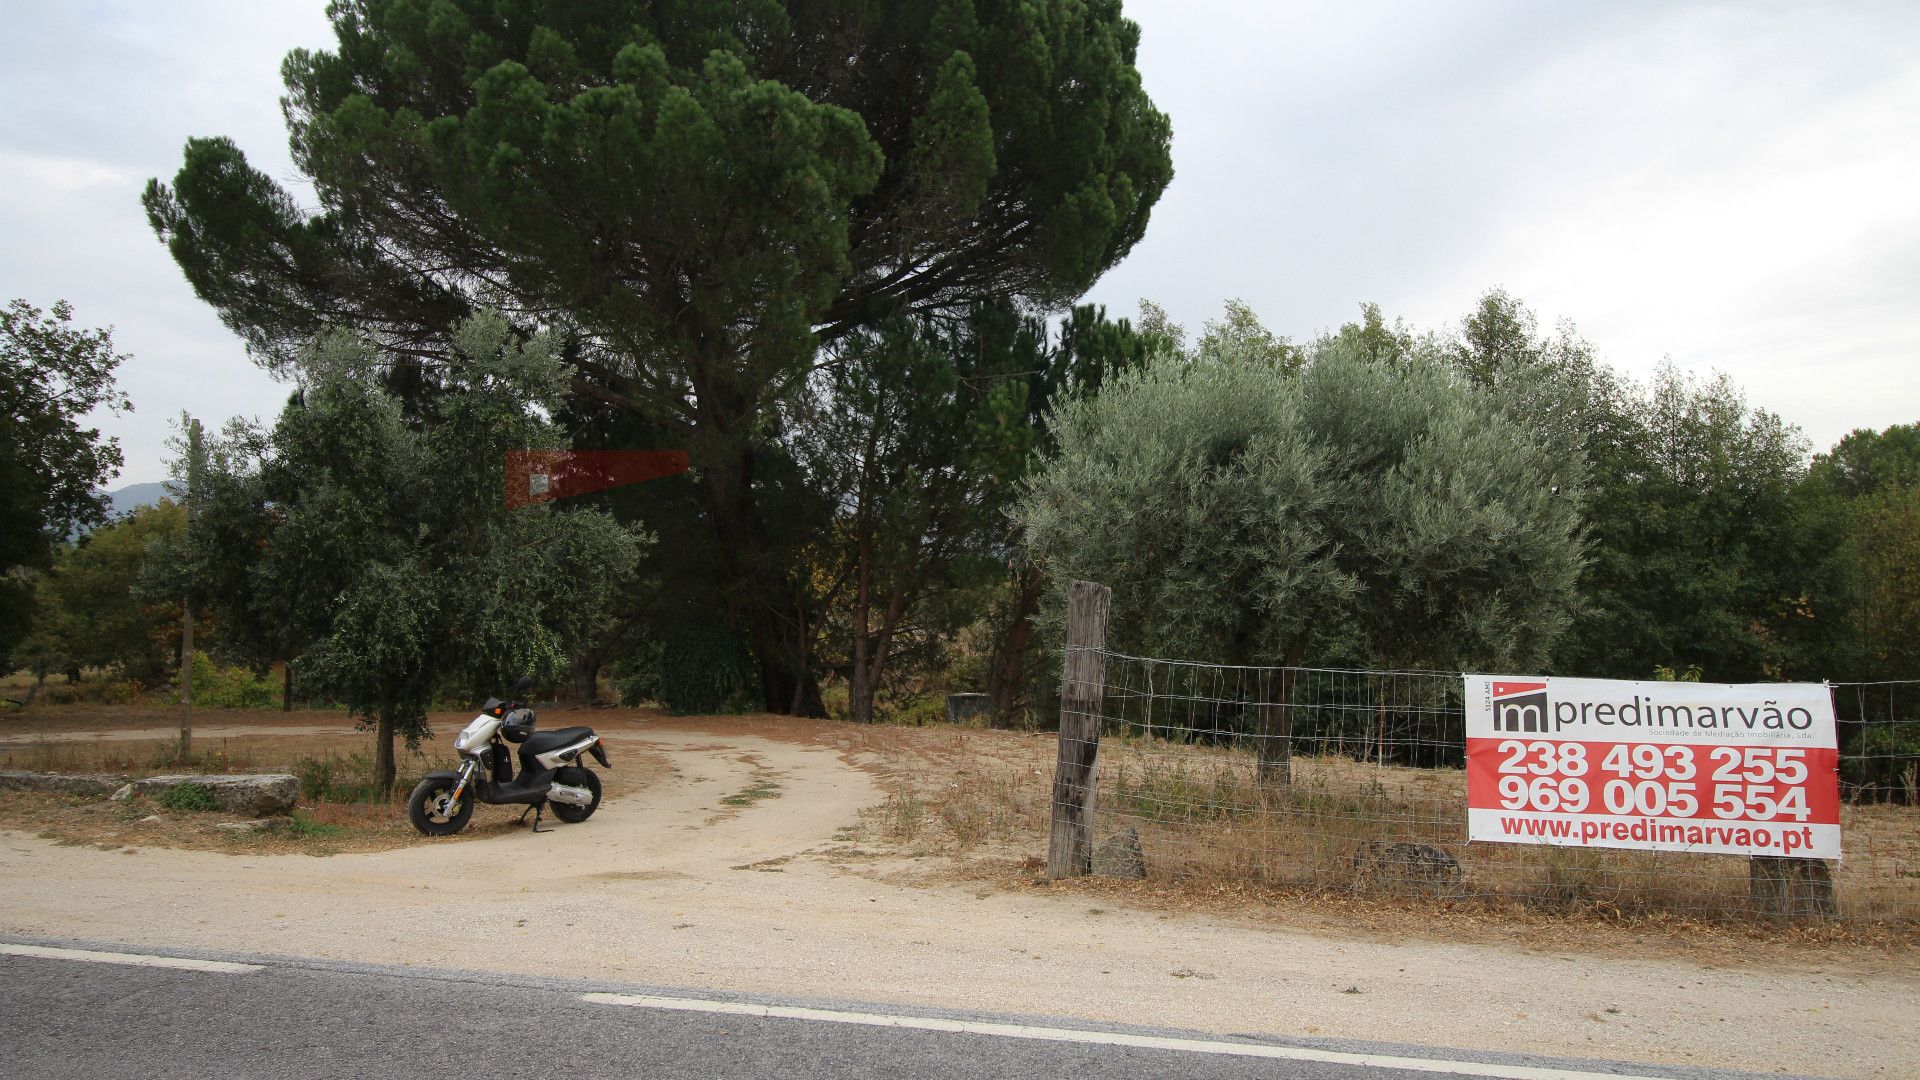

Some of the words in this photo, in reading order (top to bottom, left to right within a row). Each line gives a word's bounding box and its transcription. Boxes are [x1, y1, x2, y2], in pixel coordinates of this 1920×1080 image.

[1555, 696, 1813, 732] predimarvão
[1648, 729, 1690, 737] Sociedade
[1705, 731, 1745, 739] Mediação
[1498, 740, 1589, 776] 238
[1602, 744, 1697, 780] 493
[1710, 747, 1808, 784] 255
[1498, 776, 1590, 812] 969
[1603, 780, 1698, 817] 005
[1713, 784, 1812, 822] 554
[1501, 817, 1814, 855] www.predimarvao.pt
